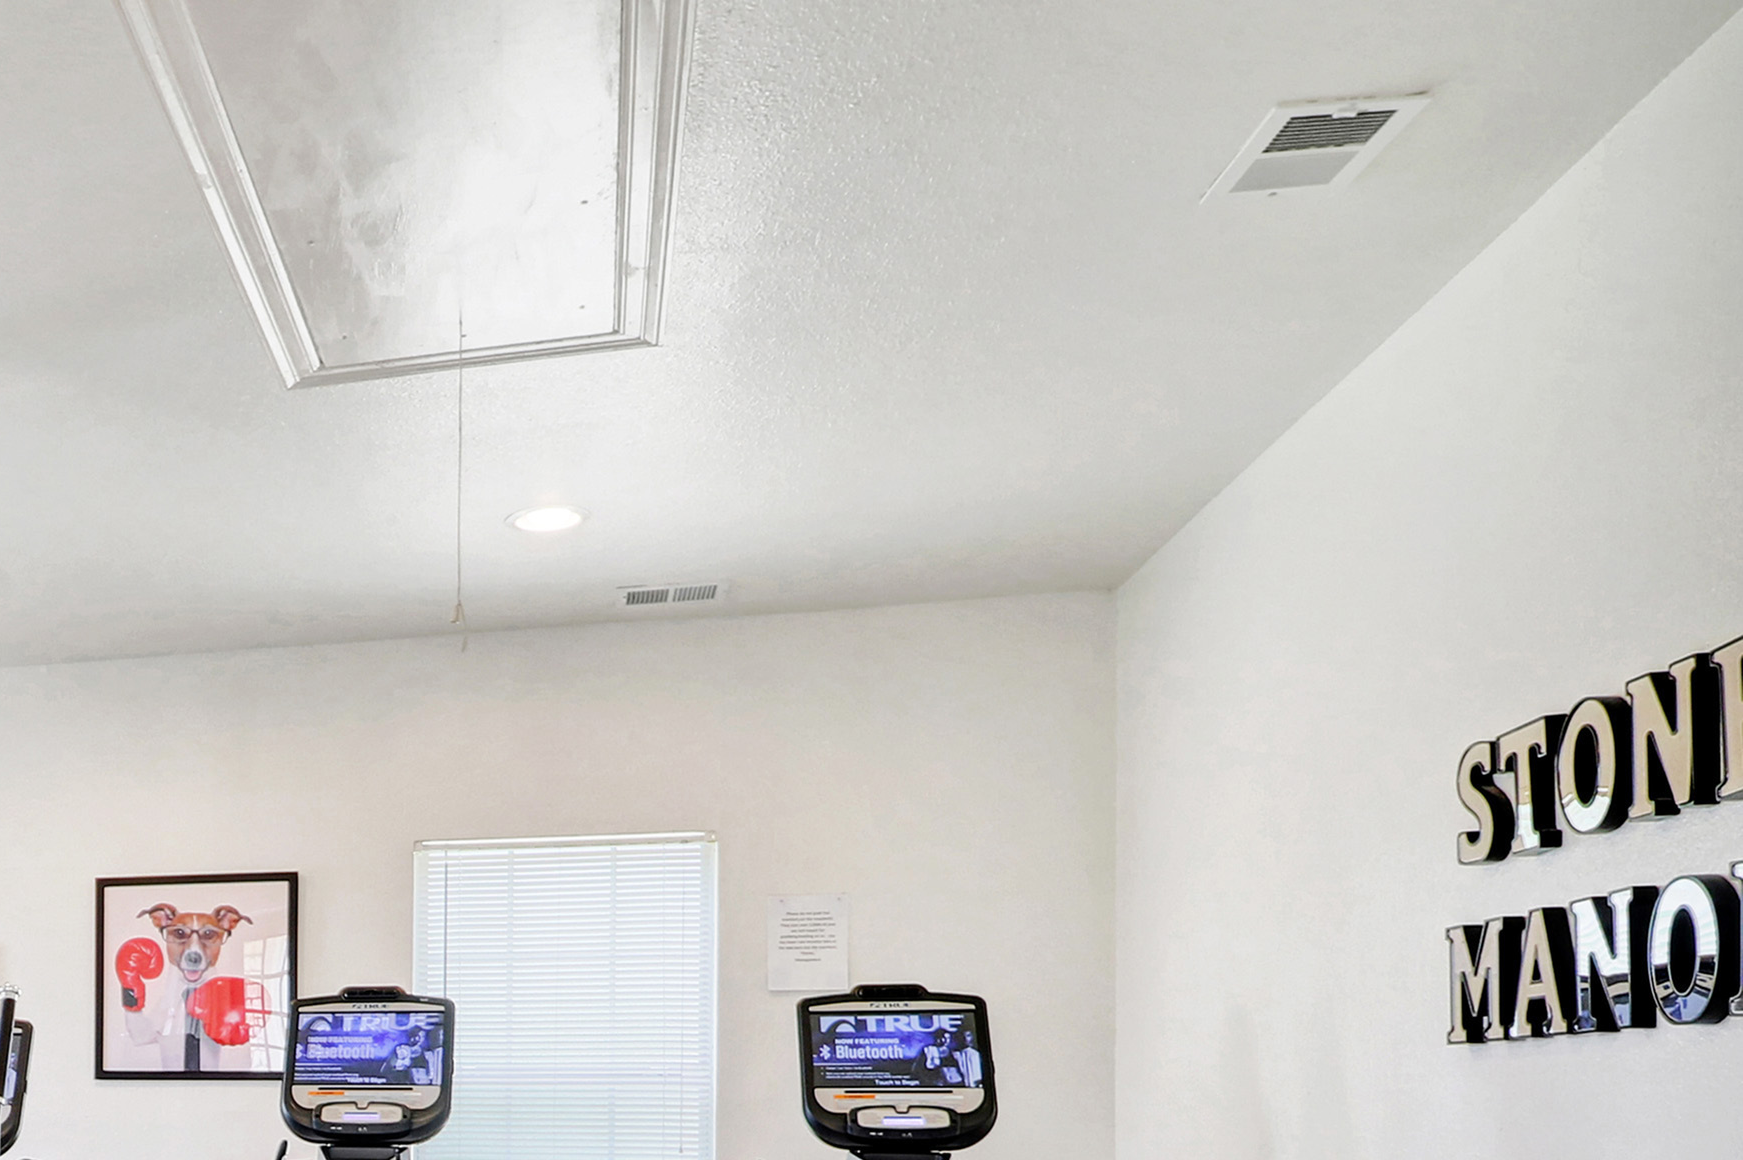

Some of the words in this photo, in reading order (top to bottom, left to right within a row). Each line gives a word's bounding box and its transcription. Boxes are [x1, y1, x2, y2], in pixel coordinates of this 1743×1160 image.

[1445, 861, 1743, 1045] MANO
[334, 1012, 440, 1031] TRUE
[857, 1014, 964, 1032] TRUE
[835, 1044, 904, 1060] Bluetooth
